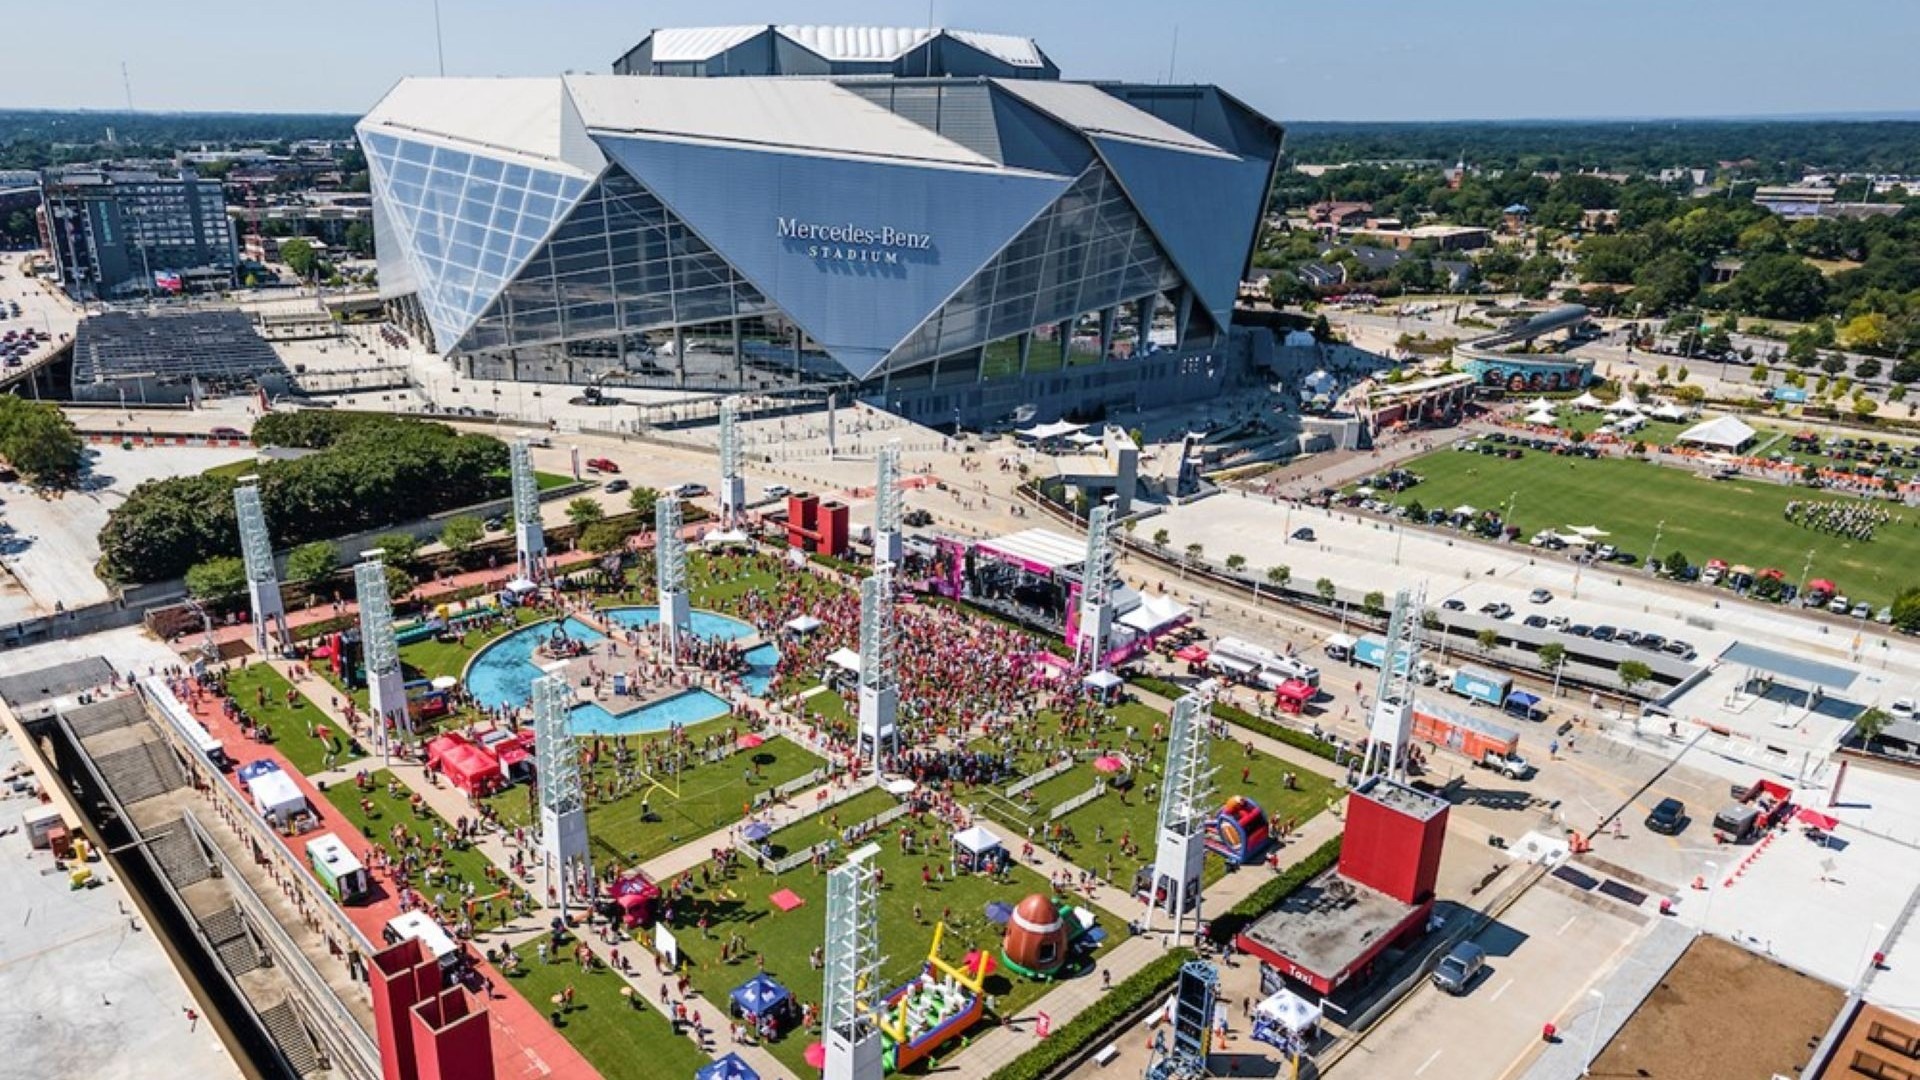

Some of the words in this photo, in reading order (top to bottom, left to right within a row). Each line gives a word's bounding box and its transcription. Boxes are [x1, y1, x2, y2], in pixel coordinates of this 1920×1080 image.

[777, 216, 930, 249] Mercedes-Benz
[808, 246, 897, 263] STADIUM
[1289, 965, 1313, 985] Taxi
